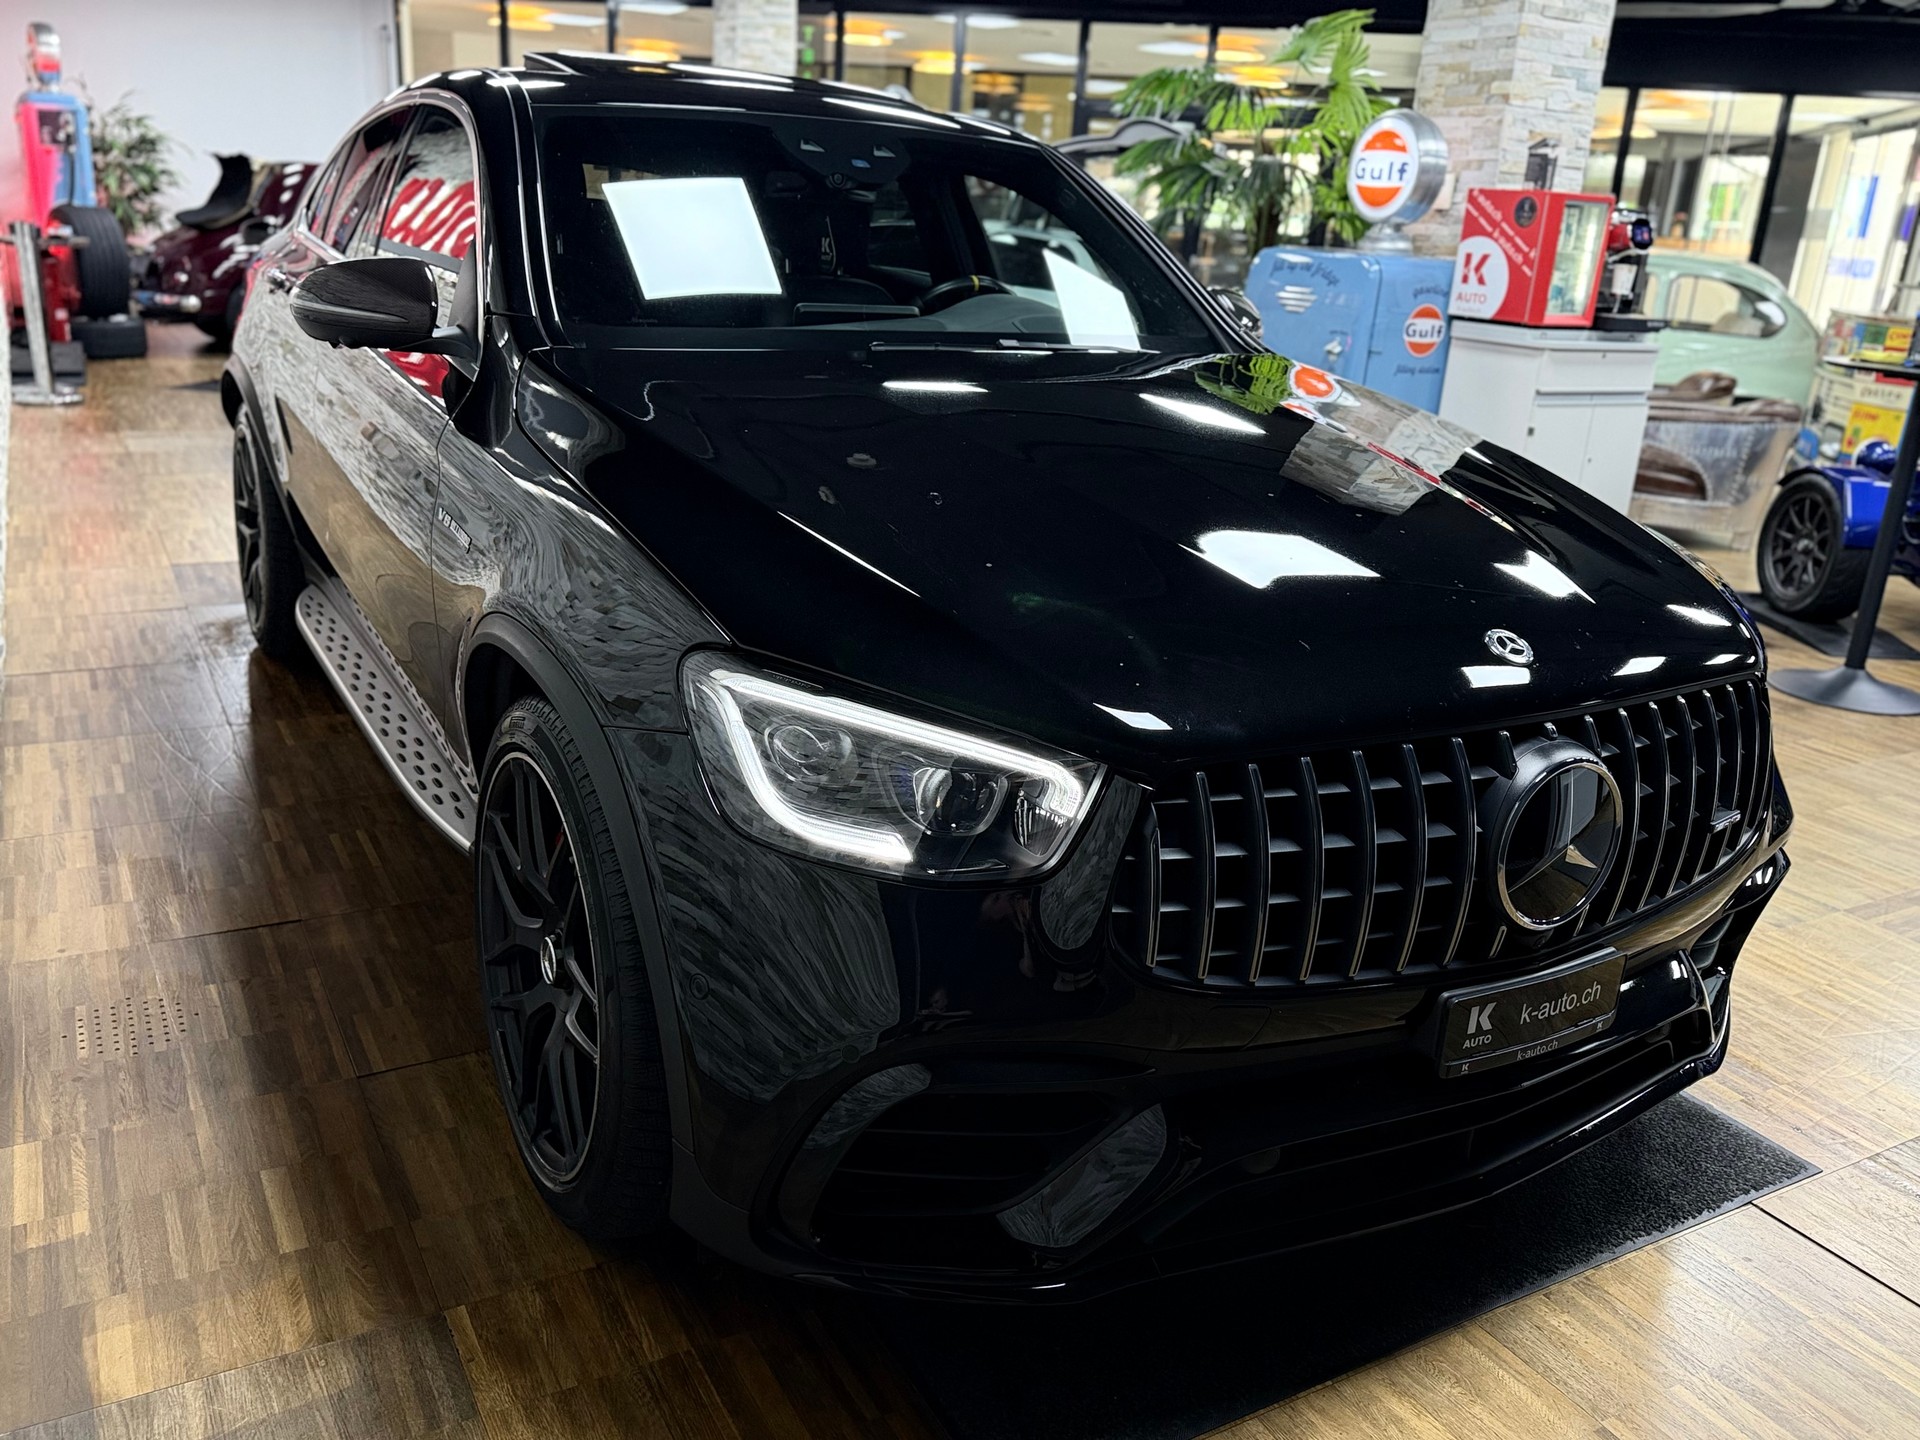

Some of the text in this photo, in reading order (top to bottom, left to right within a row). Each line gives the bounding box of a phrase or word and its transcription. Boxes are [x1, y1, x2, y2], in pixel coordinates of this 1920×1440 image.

[1355, 158, 1409, 182] Gulf
[820, 237, 831, 253] K
[1461, 253, 1491, 286] K
[1456, 292, 1487, 304] AUTO
[1405, 323, 1444, 339] Gulf
[1520, 981, 1601, 1025] k-auto.ch
[1467, 1002, 1497, 1035] K
[1462, 1034, 1492, 1050] AUTO
[1517, 1040, 1558, 1061] k-auto.ch
